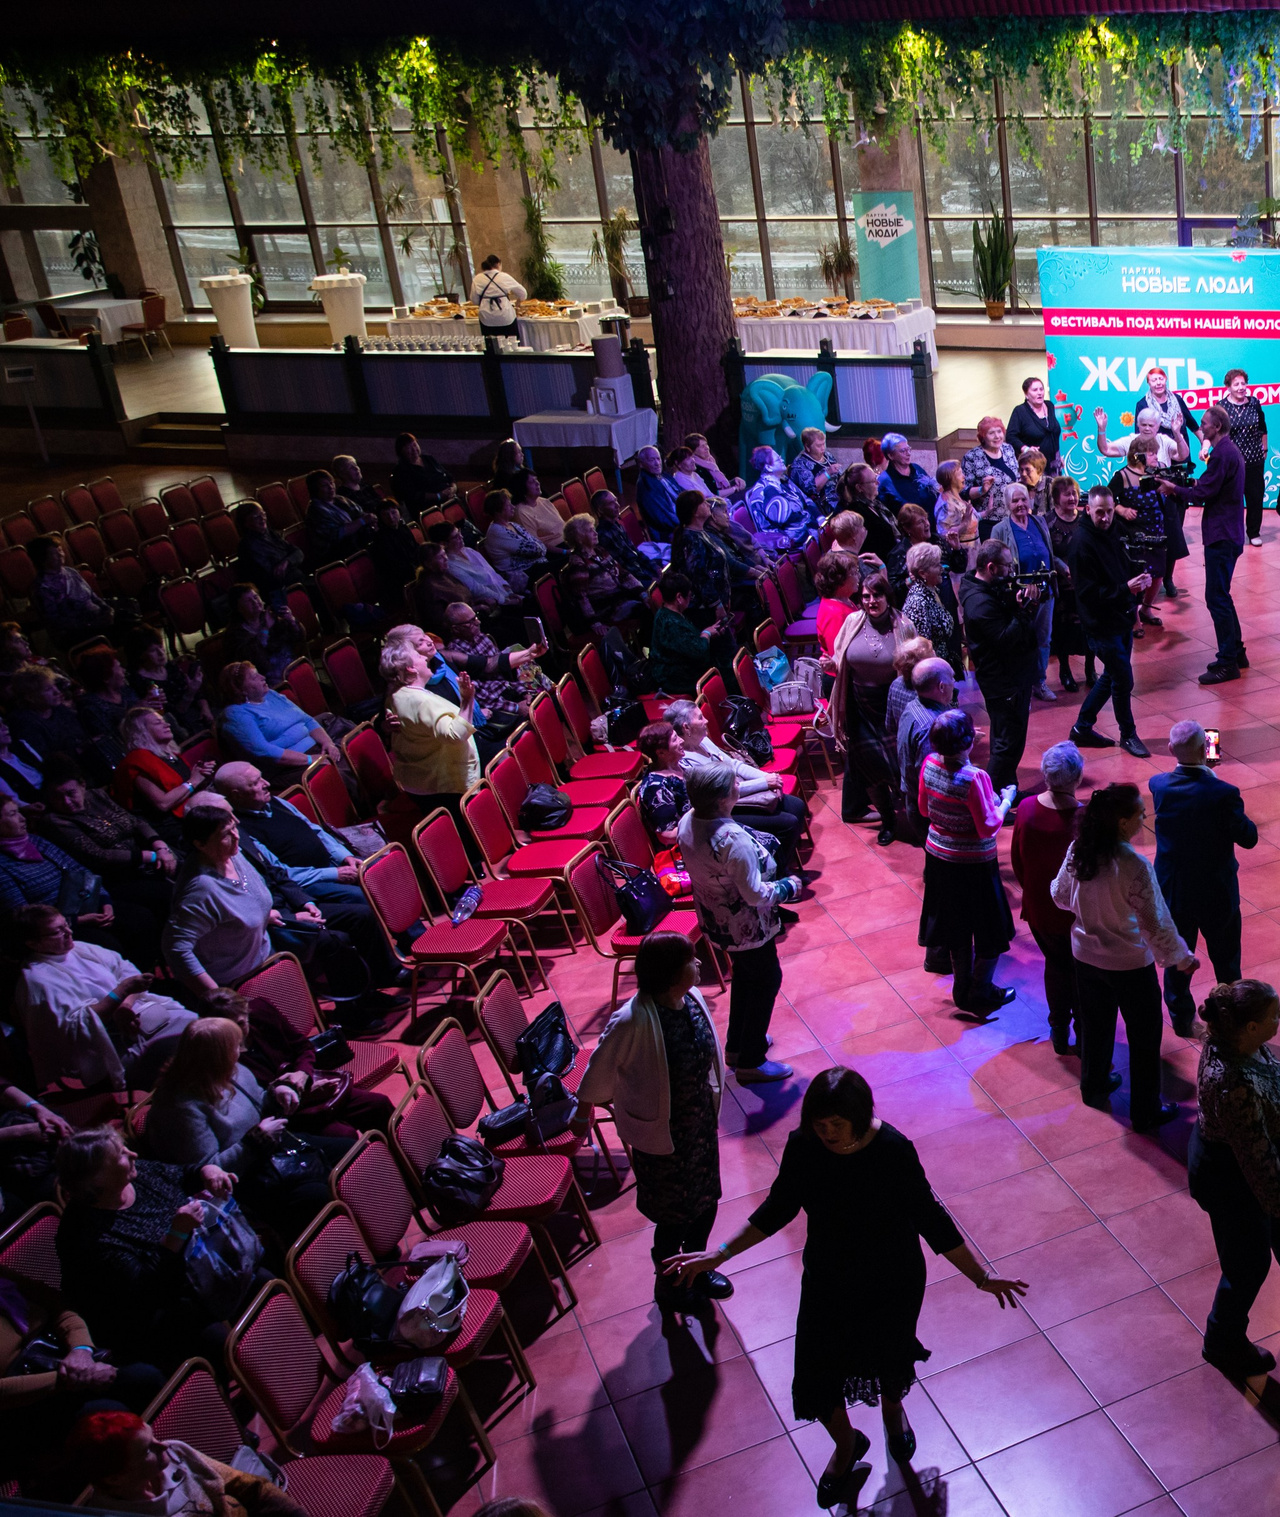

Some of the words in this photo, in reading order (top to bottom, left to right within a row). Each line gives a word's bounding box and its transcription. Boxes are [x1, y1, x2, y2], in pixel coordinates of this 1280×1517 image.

[866, 218, 904, 228] НОВЫЕ
[867, 228, 899, 238] ЛЮДИ
[1121, 267, 1161, 275] ПАРТИЯ
[1121, 276, 1191, 293] НОВЫЕ
[1195, 276, 1254, 294] ЛЮДИ
[1050, 316, 1124, 328] ФЕСТИВАЛЬ
[1126, 317, 1155, 330] ПОД
[1156, 317, 1192, 329] ХИТЫ
[1194, 316, 1241, 330] НАШЕЙ
